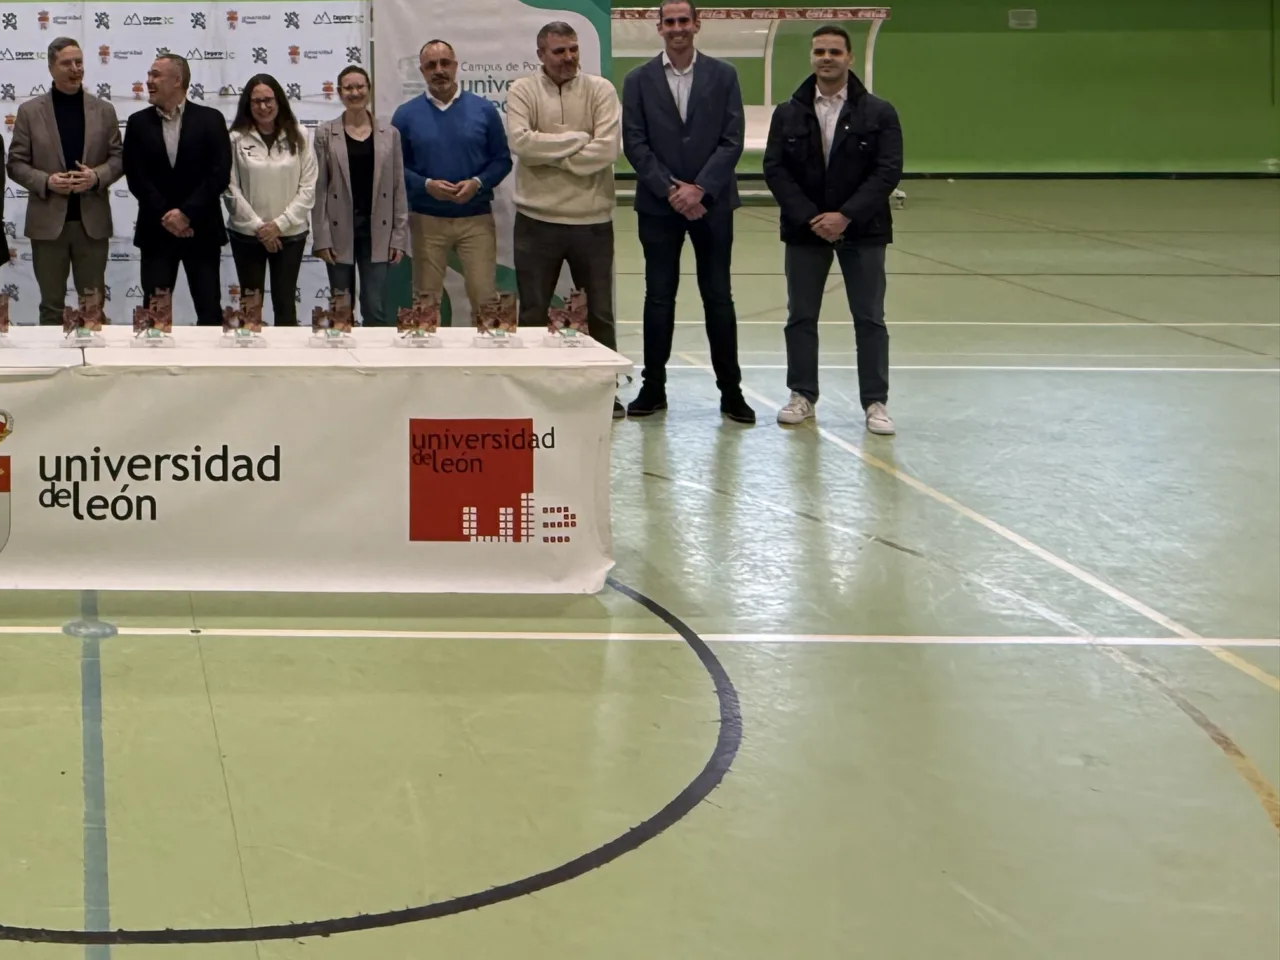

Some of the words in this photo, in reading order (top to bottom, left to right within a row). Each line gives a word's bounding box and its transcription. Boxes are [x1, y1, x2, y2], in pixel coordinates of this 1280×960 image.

[461, 62, 502, 73] Campus
[506, 62, 520, 72] de
[412, 426, 555, 450] universidad
[39, 444, 281, 482] universidad
[412, 450, 432, 466] de
[432, 449, 483, 473] león
[38, 481, 72, 508] de
[72, 481, 157, 521] león
